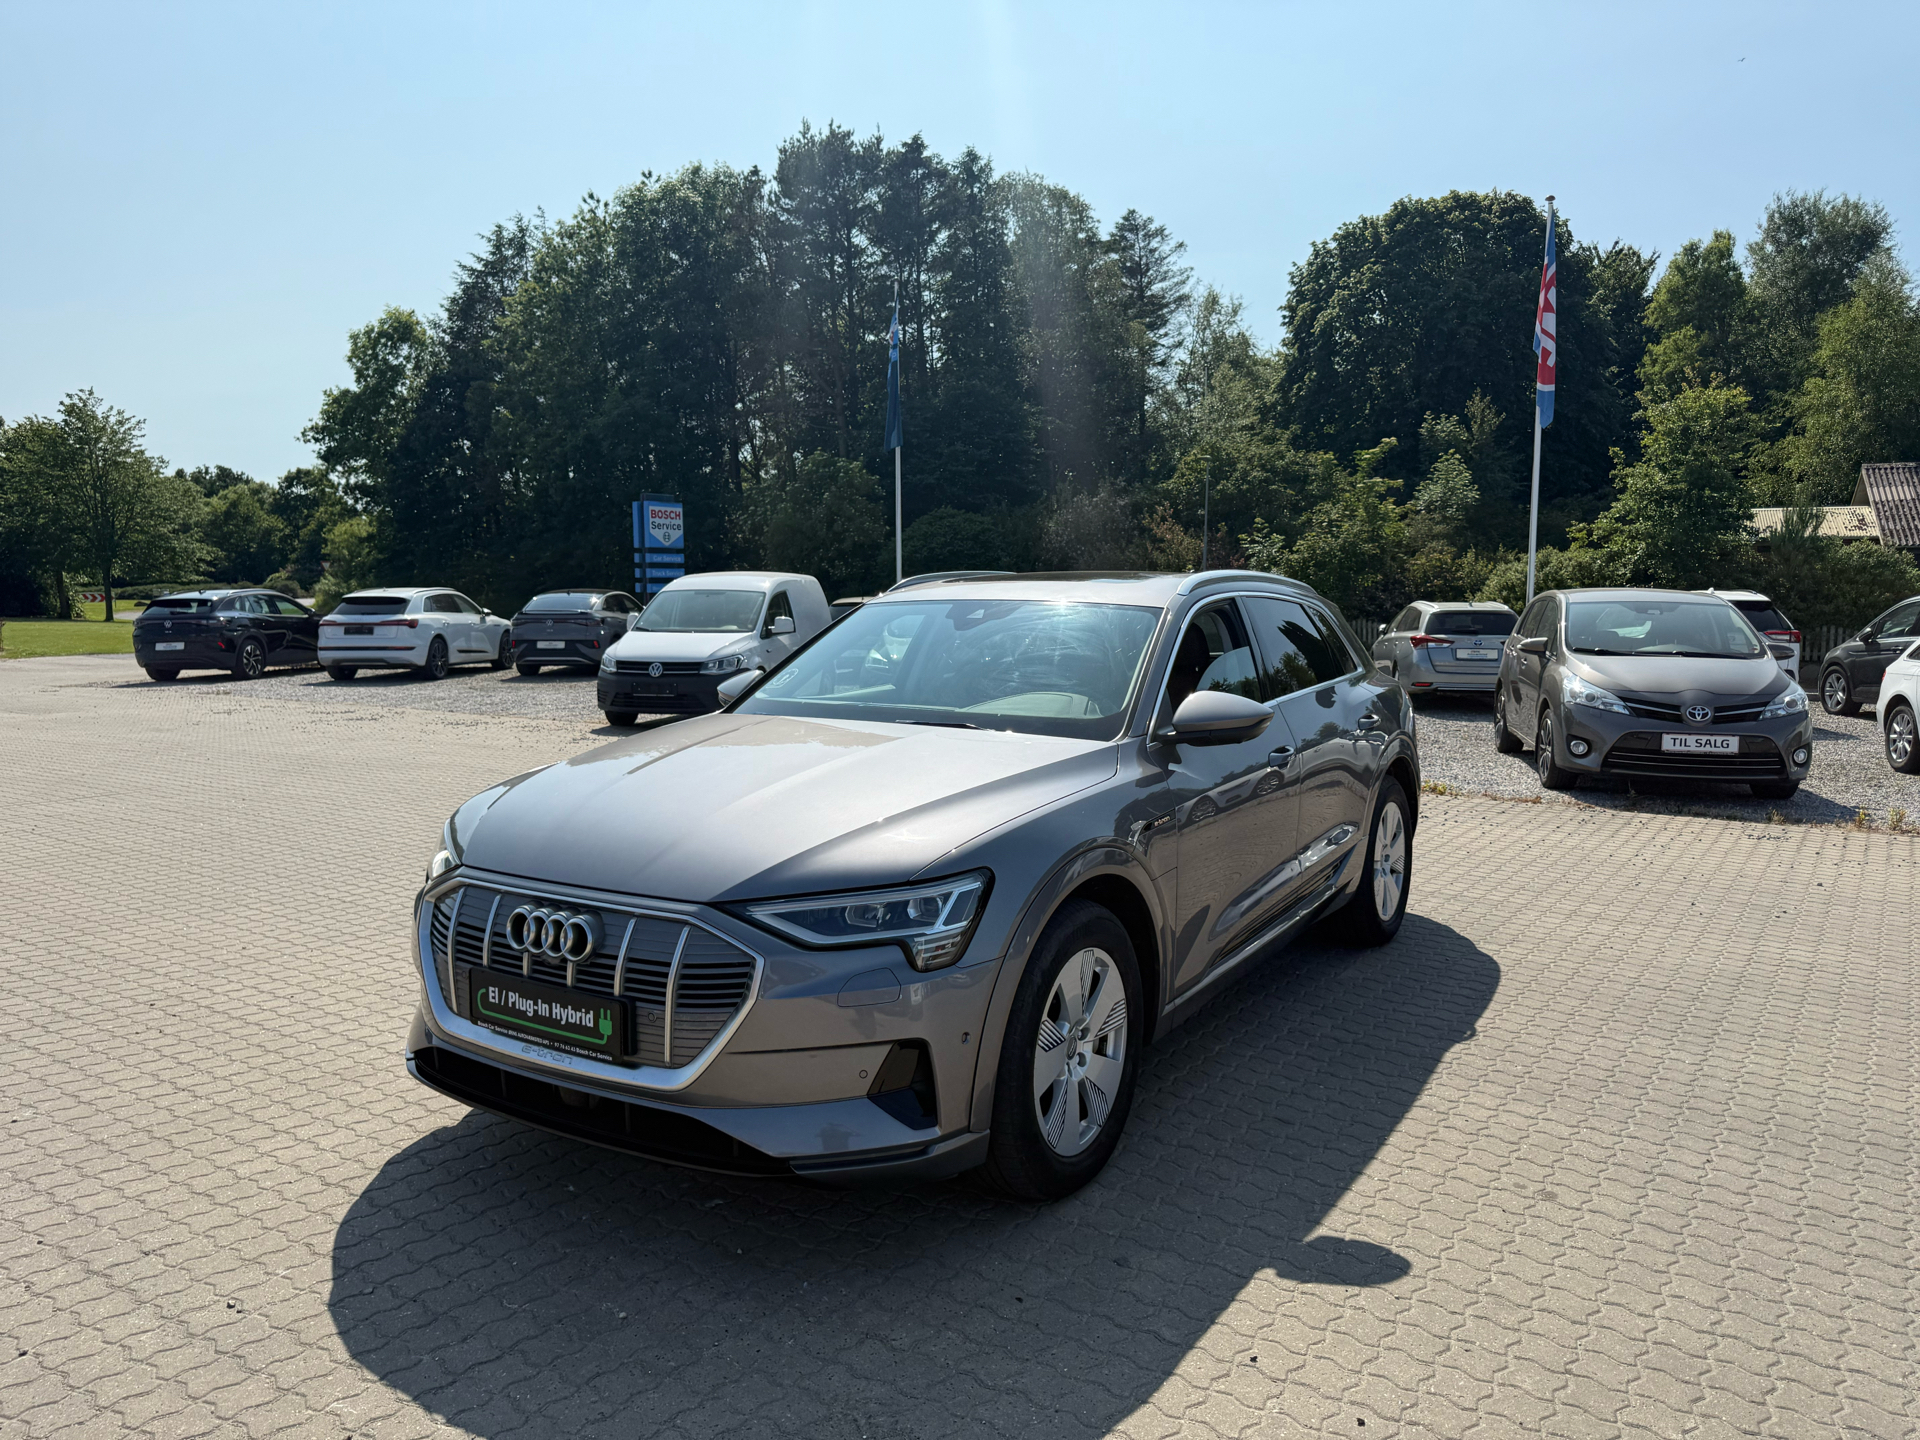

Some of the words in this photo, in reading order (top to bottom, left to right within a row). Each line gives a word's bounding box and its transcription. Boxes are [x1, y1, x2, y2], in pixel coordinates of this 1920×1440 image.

[650, 509, 681, 520] BOSCH
[651, 520, 682, 531] Service
[1670, 737, 1691, 748] TIL
[1694, 738, 1730, 749] SALG
[488, 985, 499, 1004] El
[508, 991, 549, 1017] Plug-In
[552, 1002, 594, 1028] Hybrid
[495, 1025, 508, 1034] Service
[576, 1047, 588, 1056] Bosch
[597, 1052, 613, 1061] Service
